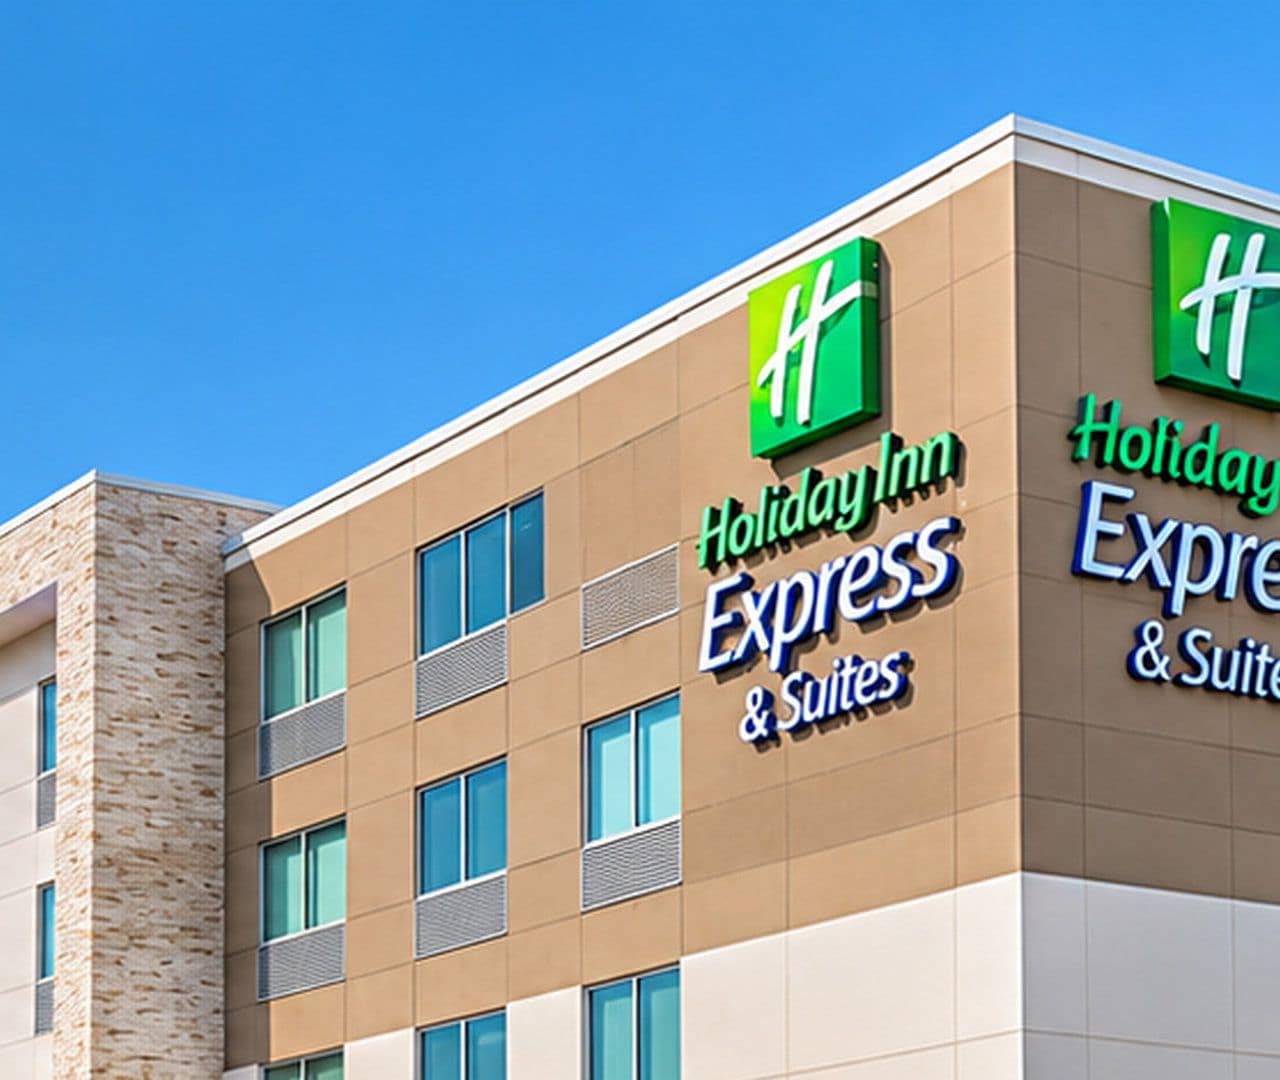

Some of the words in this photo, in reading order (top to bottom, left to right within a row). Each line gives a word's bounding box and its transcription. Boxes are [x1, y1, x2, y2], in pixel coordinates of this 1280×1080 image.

[756, 259, 862, 426] H
[697, 464, 874, 570] Holiday
[874, 431, 958, 503] Inn
[698, 516, 960, 673] Express
[1128, 619, 1171, 681] &
[738, 685, 772, 743] &
[776, 651, 907, 732] Suites
